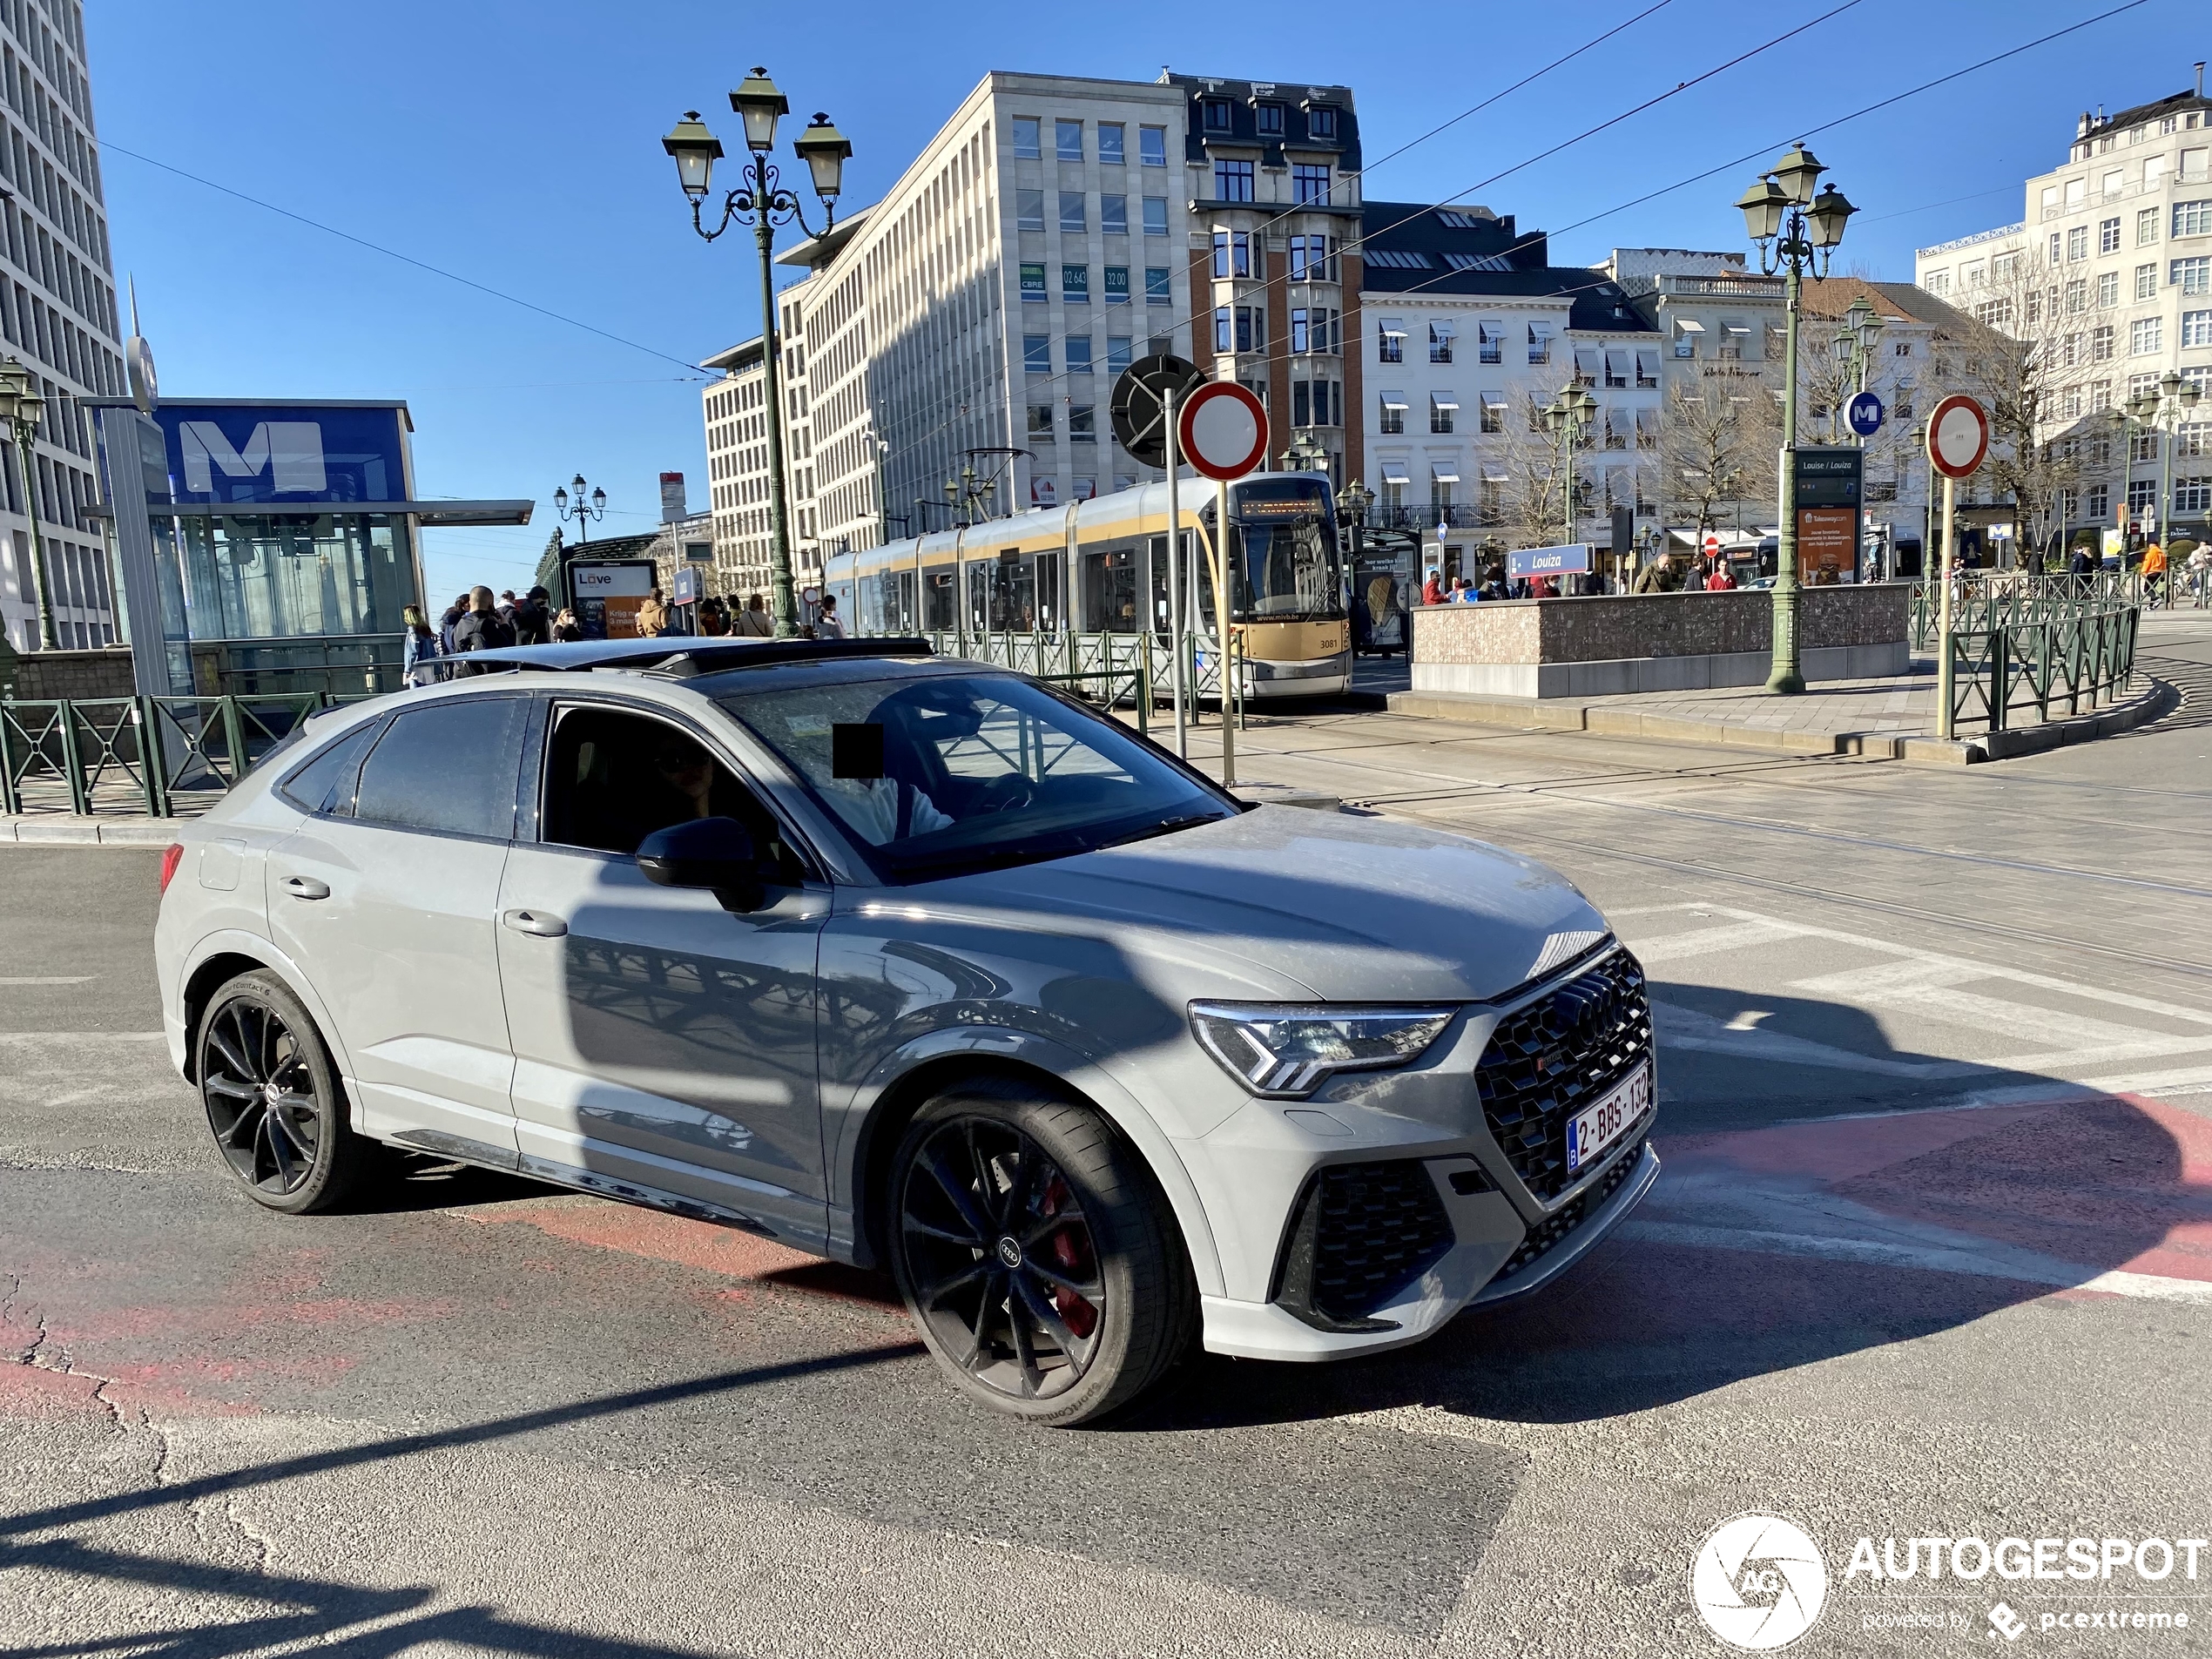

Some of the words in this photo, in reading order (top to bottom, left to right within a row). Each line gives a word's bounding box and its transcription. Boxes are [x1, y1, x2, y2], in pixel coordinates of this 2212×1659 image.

[1063, 271, 1072, 283] 02
[1074, 272, 1086, 284] 643
[1107, 273, 1116, 285] 32
[1116, 273, 1126, 286] 00
[1854, 405, 1878, 422] M
[1803, 461, 1824, 469] Louise
[1532, 553, 1561, 569] Louiza
[610, 610, 627, 618] Krijg
[1320, 639, 1338, 649] 3081
[1570, 1149, 1576, 1166] B
[1026, 1382, 1102, 1422] SportContact
